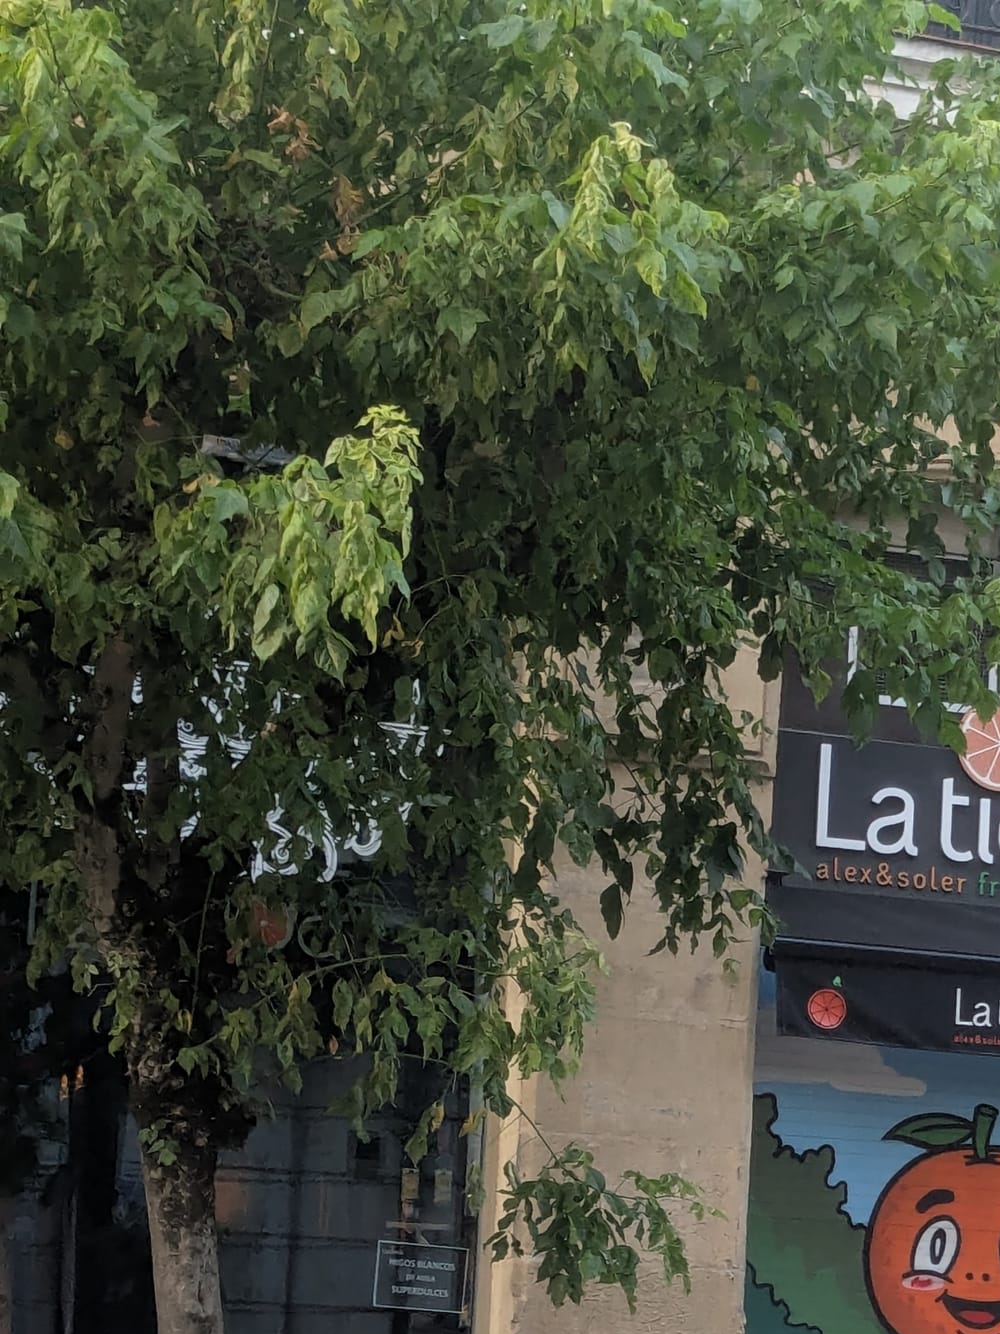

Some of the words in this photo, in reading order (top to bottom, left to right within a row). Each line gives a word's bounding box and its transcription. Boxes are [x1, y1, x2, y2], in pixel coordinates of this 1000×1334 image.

[816, 743, 918, 857] La
[816, 857, 967, 894] alex&soler
[955, 988, 992, 1028] La
[392, 1286, 448, 1297] SUPERDULCES
